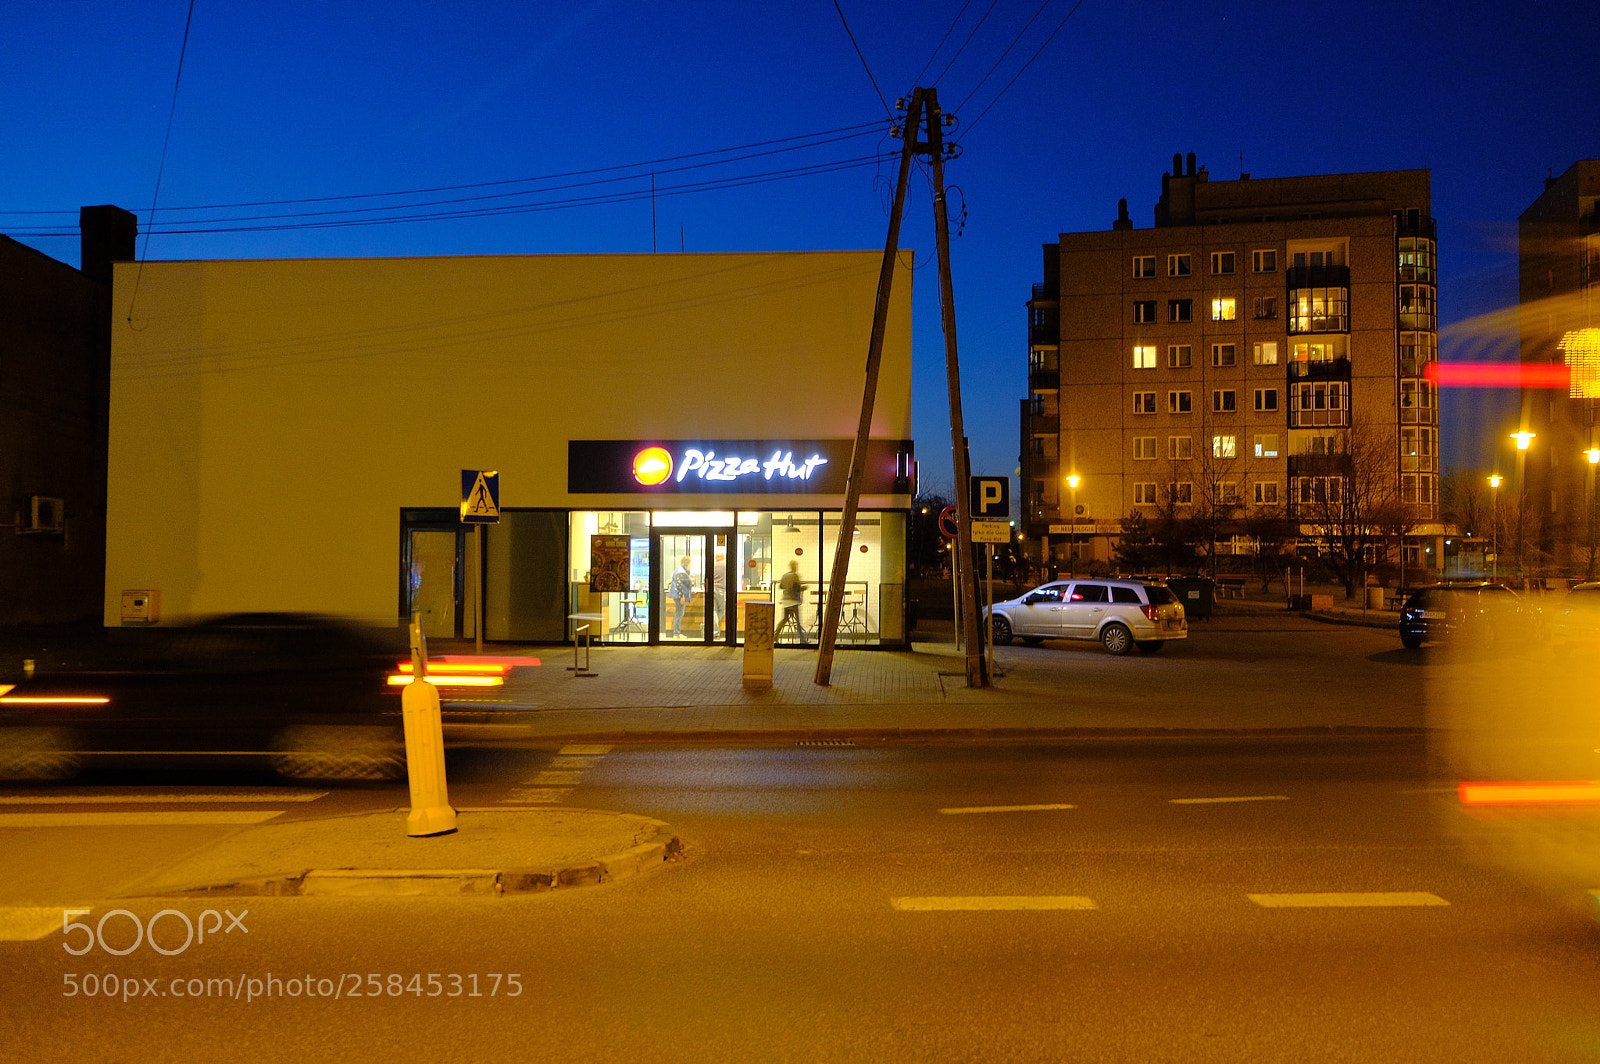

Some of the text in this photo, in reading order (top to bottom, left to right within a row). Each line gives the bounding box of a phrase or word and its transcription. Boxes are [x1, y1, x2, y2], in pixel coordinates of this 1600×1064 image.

[676, 449, 829, 483] Pizza Hut
[980, 480, 1002, 513] P
